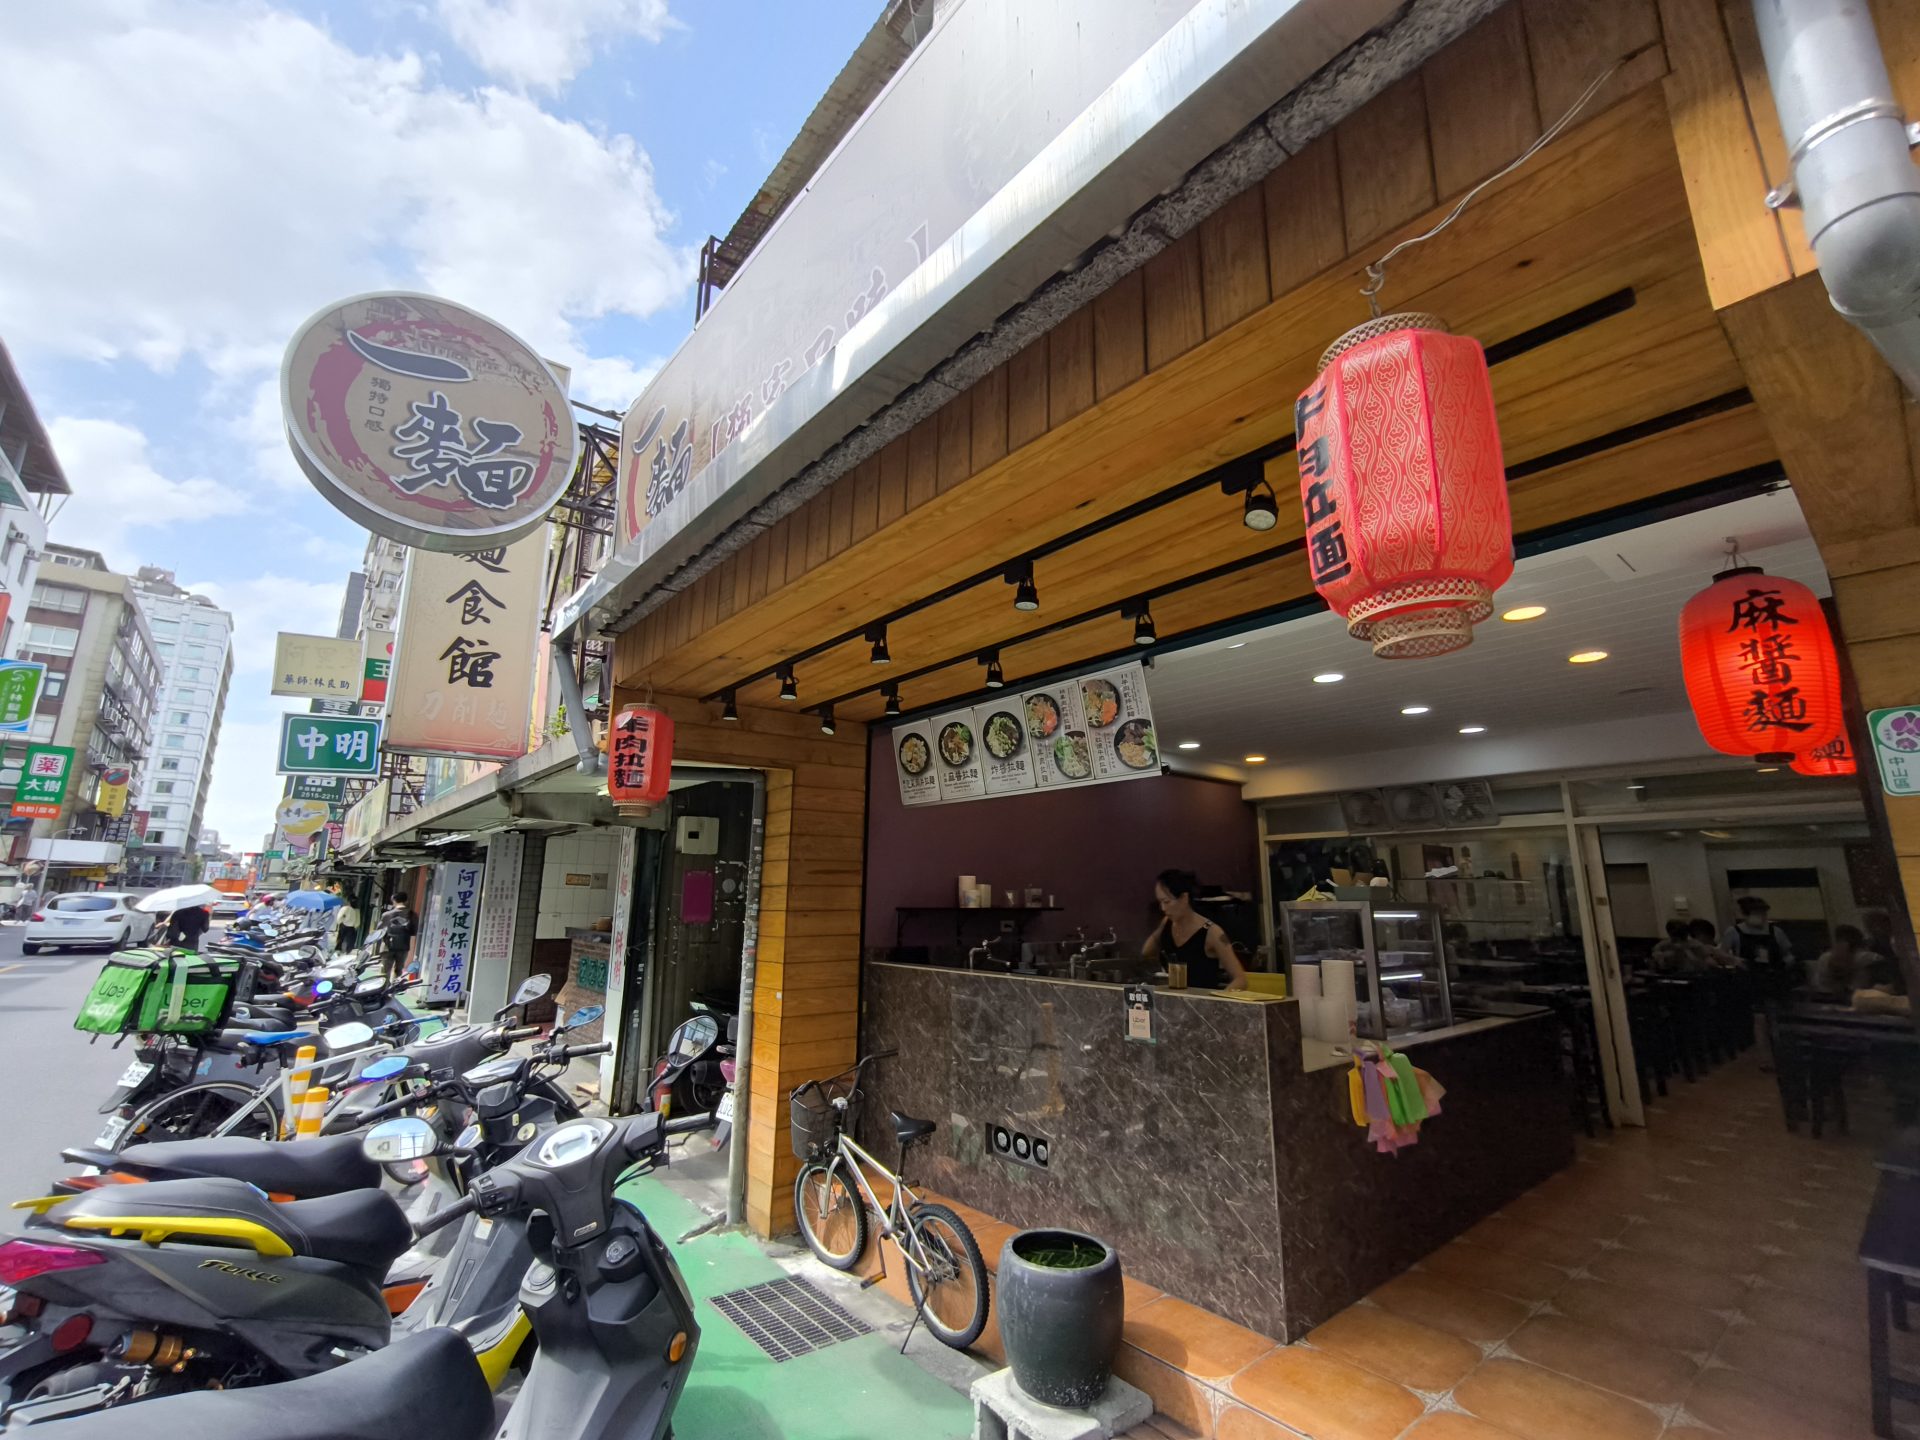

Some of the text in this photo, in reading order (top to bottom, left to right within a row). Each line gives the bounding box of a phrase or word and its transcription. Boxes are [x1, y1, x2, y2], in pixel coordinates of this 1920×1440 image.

[1726, 588, 1815, 733] 麻醬麵
[297, 726, 369, 763] 中明
[24, 778, 62, 793] 大樹
[1889, 756, 1911, 789] 中山區
[442, 868, 478, 994] 阿里健保藥局
[98, 981, 130, 998] Uber
